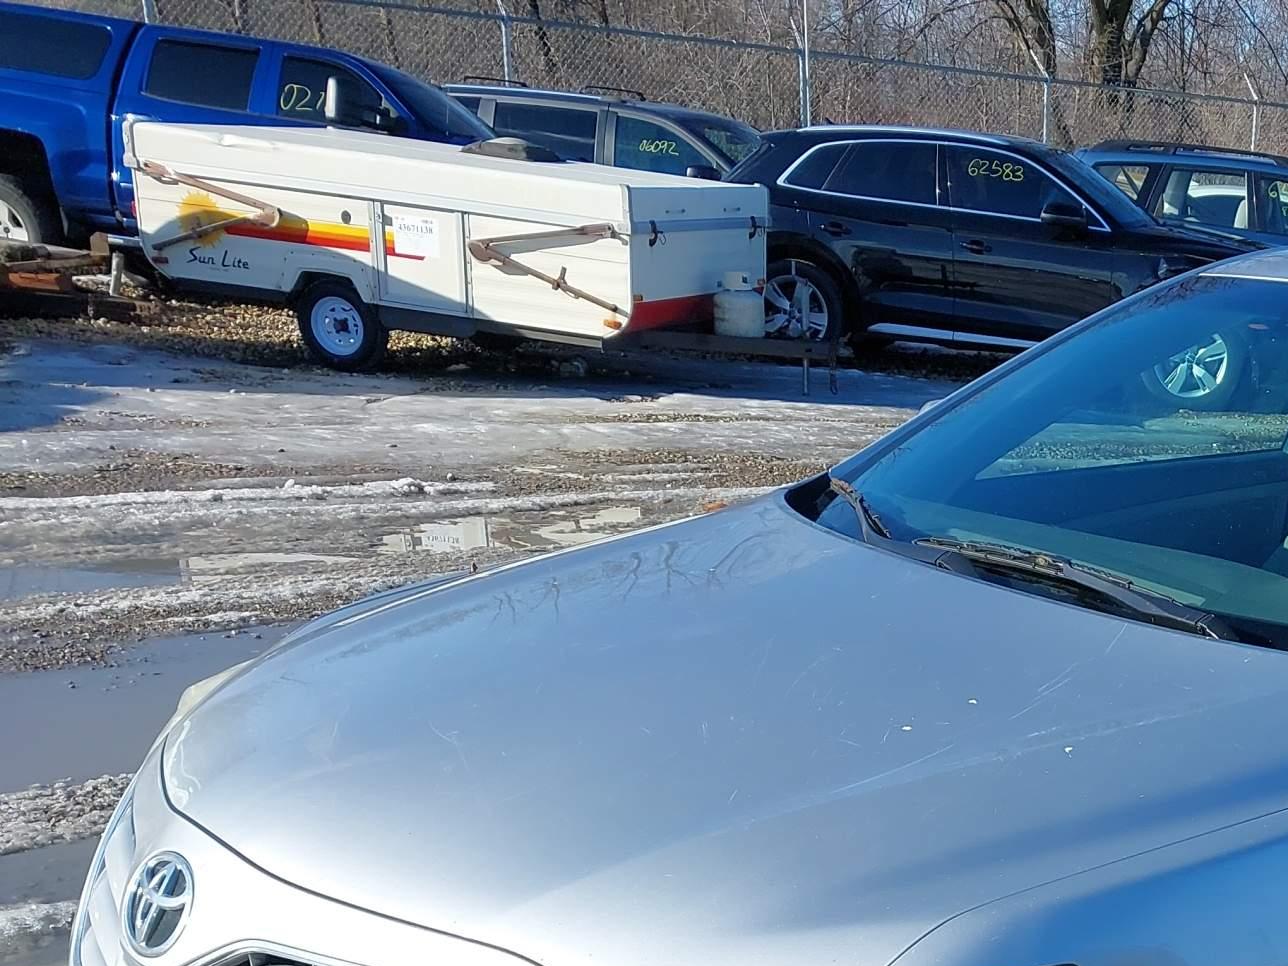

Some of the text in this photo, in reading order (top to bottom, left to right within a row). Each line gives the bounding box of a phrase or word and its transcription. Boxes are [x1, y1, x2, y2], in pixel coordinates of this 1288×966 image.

[968, 158, 1024, 181] 62583
[186, 246, 250, 270] Sun Lite
